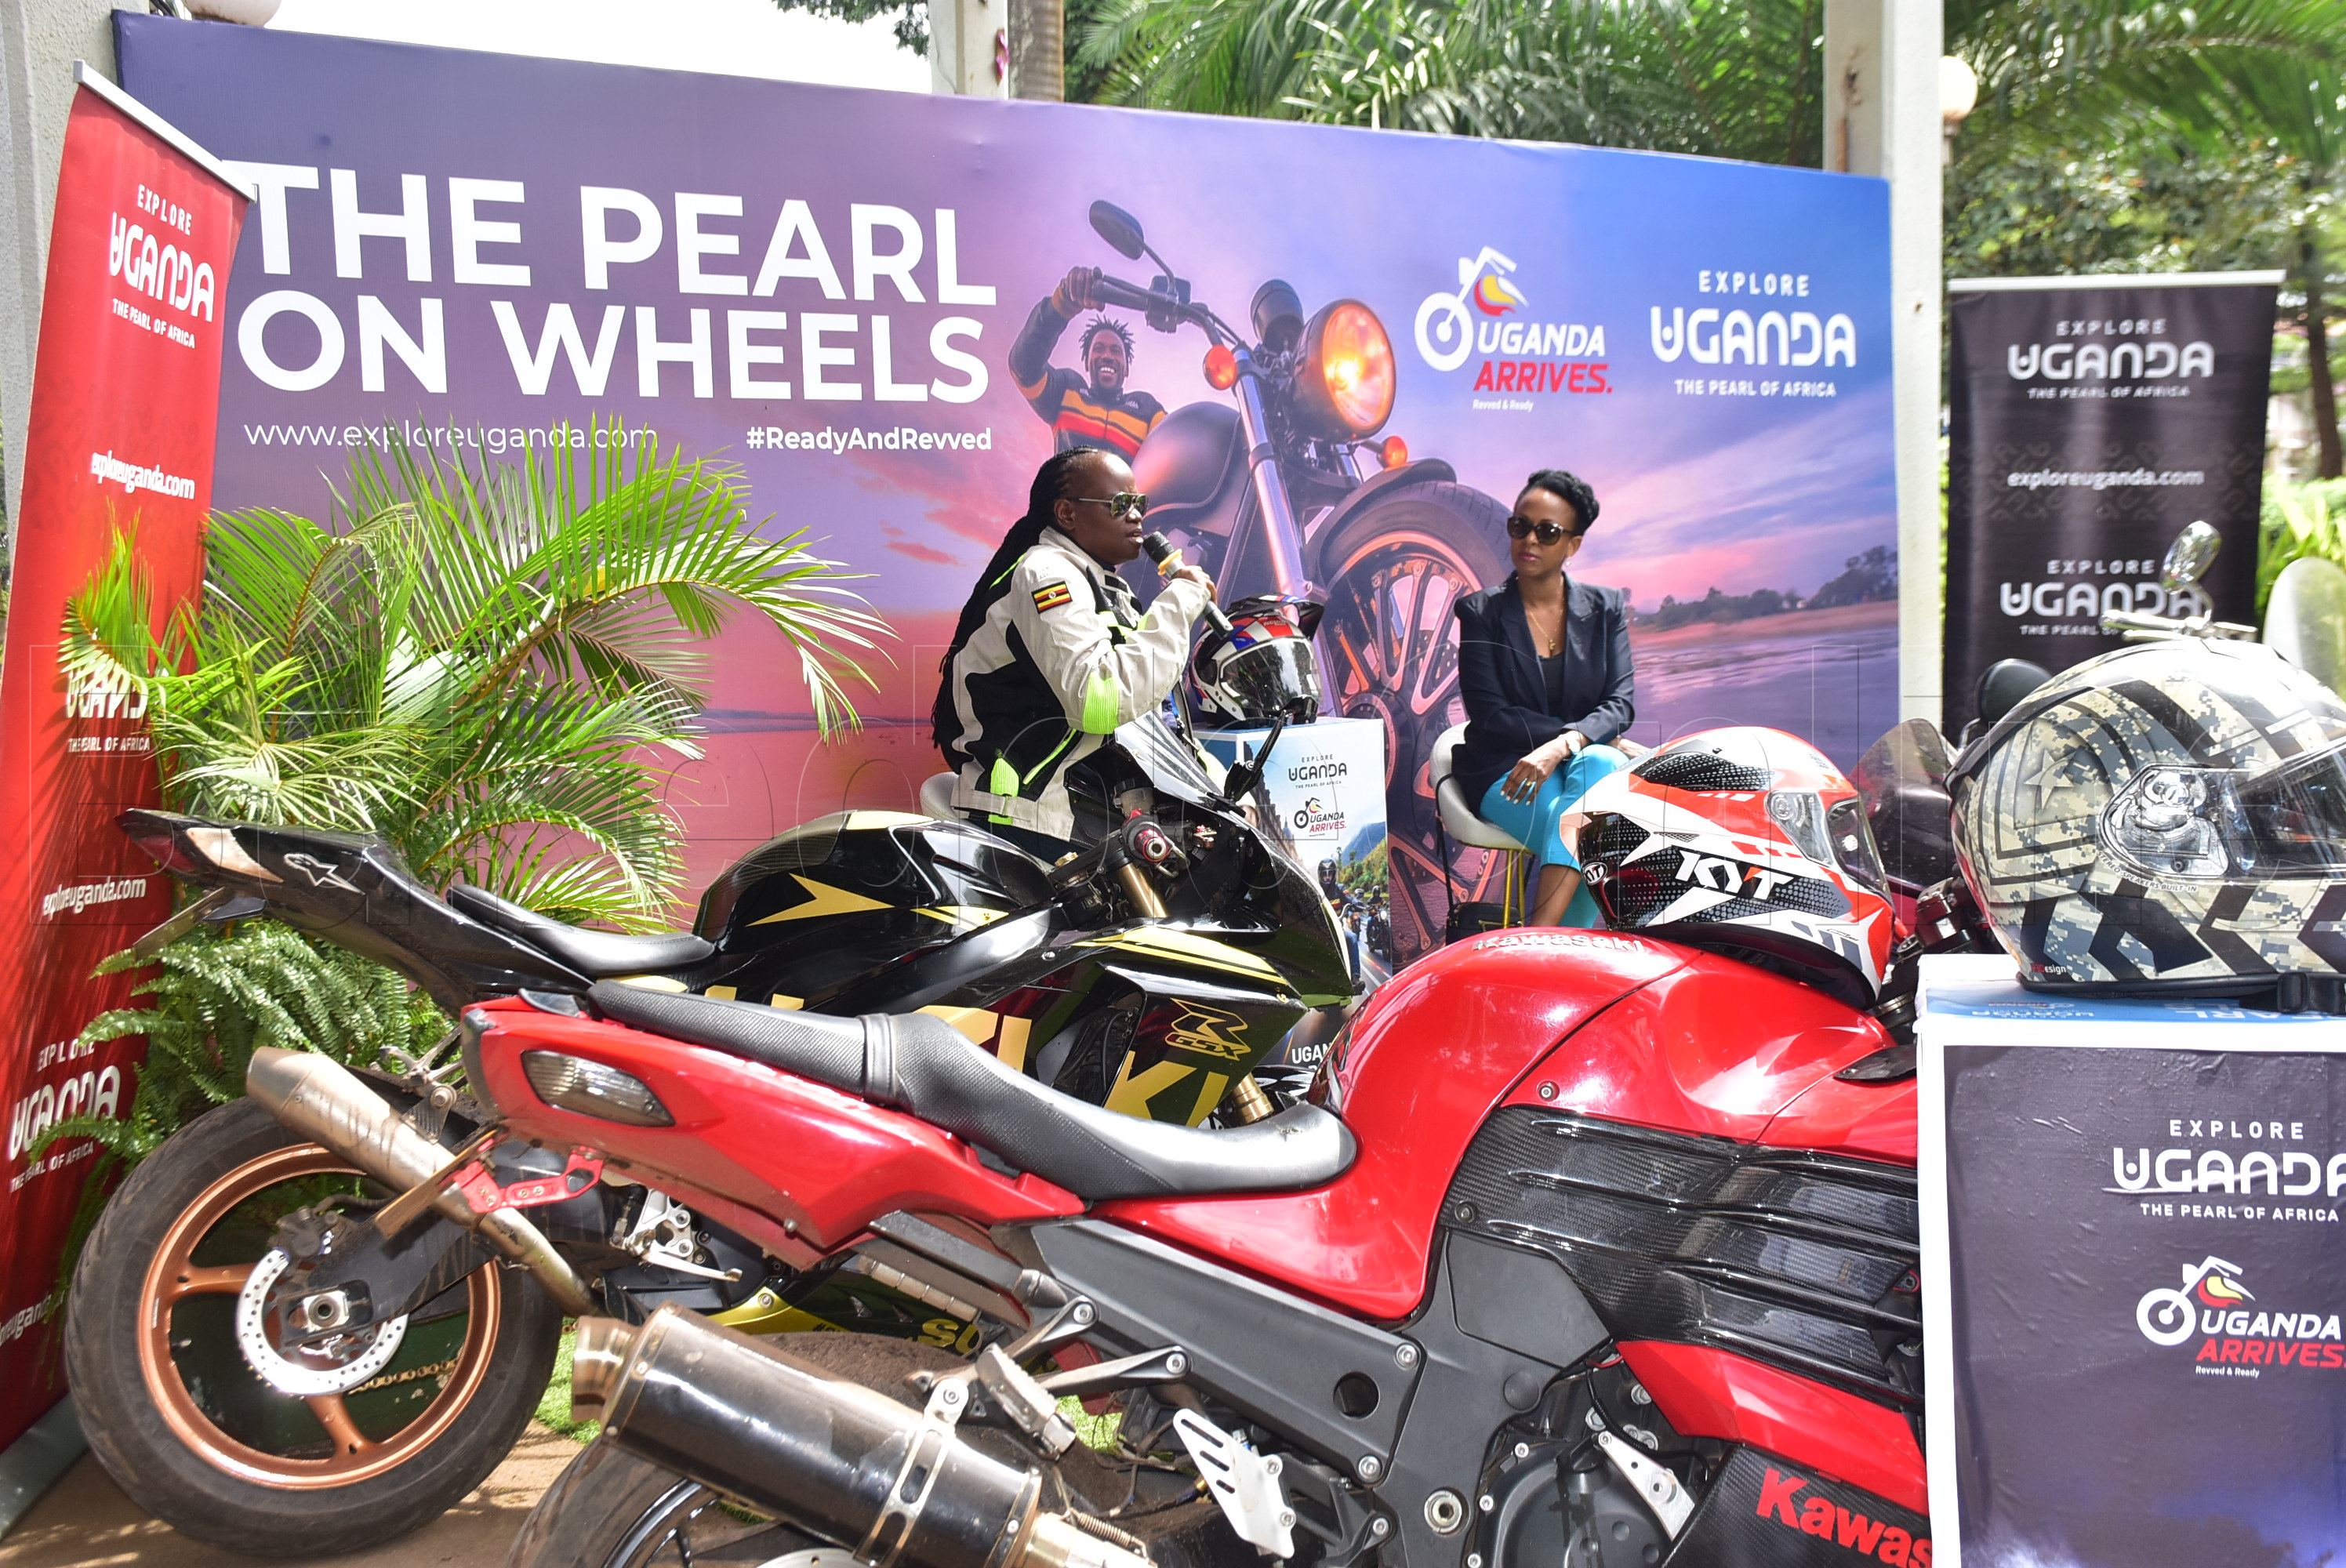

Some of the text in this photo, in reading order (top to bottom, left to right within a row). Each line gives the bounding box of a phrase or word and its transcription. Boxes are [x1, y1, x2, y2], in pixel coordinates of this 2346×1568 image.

[137, 183, 192, 236] EXPLORE
[222, 159, 997, 306] THE PEARL
[109, 211, 215, 323] UGANDA
[1698, 270, 1810, 297] EXPLORE
[112, 298, 195, 349] THE PEARL OF AFRICA
[1651, 306, 1857, 368] UGANDA
[2056, 318, 2167, 336] EXPLORE
[238, 289, 990, 404] ON WHEELS
[1477, 321, 1606, 358] UGANDA
[2007, 341, 2215, 380] UGANDA
[1473, 360, 1613, 394] ARRIVES.
[1674, 379, 1837, 397] THE PEARL OF AFRICA
[2027, 385, 2191, 399] THE PEARL OF AFRICA
[244, 419, 658, 454] www.exploreuganda.com
[746, 426, 992, 455] #ReadyAndRevved
[2007, 467, 2205, 490] exploreuganda.com
[2046, 560, 2155, 575] EXPLORE
[2000, 582, 2204, 617] UGANDA
[2019, 625, 2048, 635] THE
[2051, 625, 2099, 636] PEARL
[67, 738, 81, 753] THE
[104, 737, 118, 752] OF
[121, 737, 151, 752] AFRICA
[1302, 754, 1334, 763] EXPLORE
[1288, 763, 1347, 782] UGANDA
[1309, 821, 1346, 833] ARRIVES.
[1310, 811, 1345, 823] UGANDA
[1675, 849, 1795, 901] KYT
[1473, 934, 1645, 953] Kawasaki
[1292, 1042, 1332, 1065] UGAN
[2169, 1119, 2304, 1139] EXPLORE
[10, 1172, 26, 1193] THE
[49, 1153, 66, 1171] OF
[66, 1141, 93, 1167] AFRICA
[2113, 1147, 2346, 1196] UGANDA
[2141, 1203, 2339, 1222] THE PEARL OF AFRICA
[2201, 1309, 2341, 1341] UGANDA
[2195, 1365, 2260, 1379] Revved & Ready
[1756, 1467, 1933, 1568] Kawas
